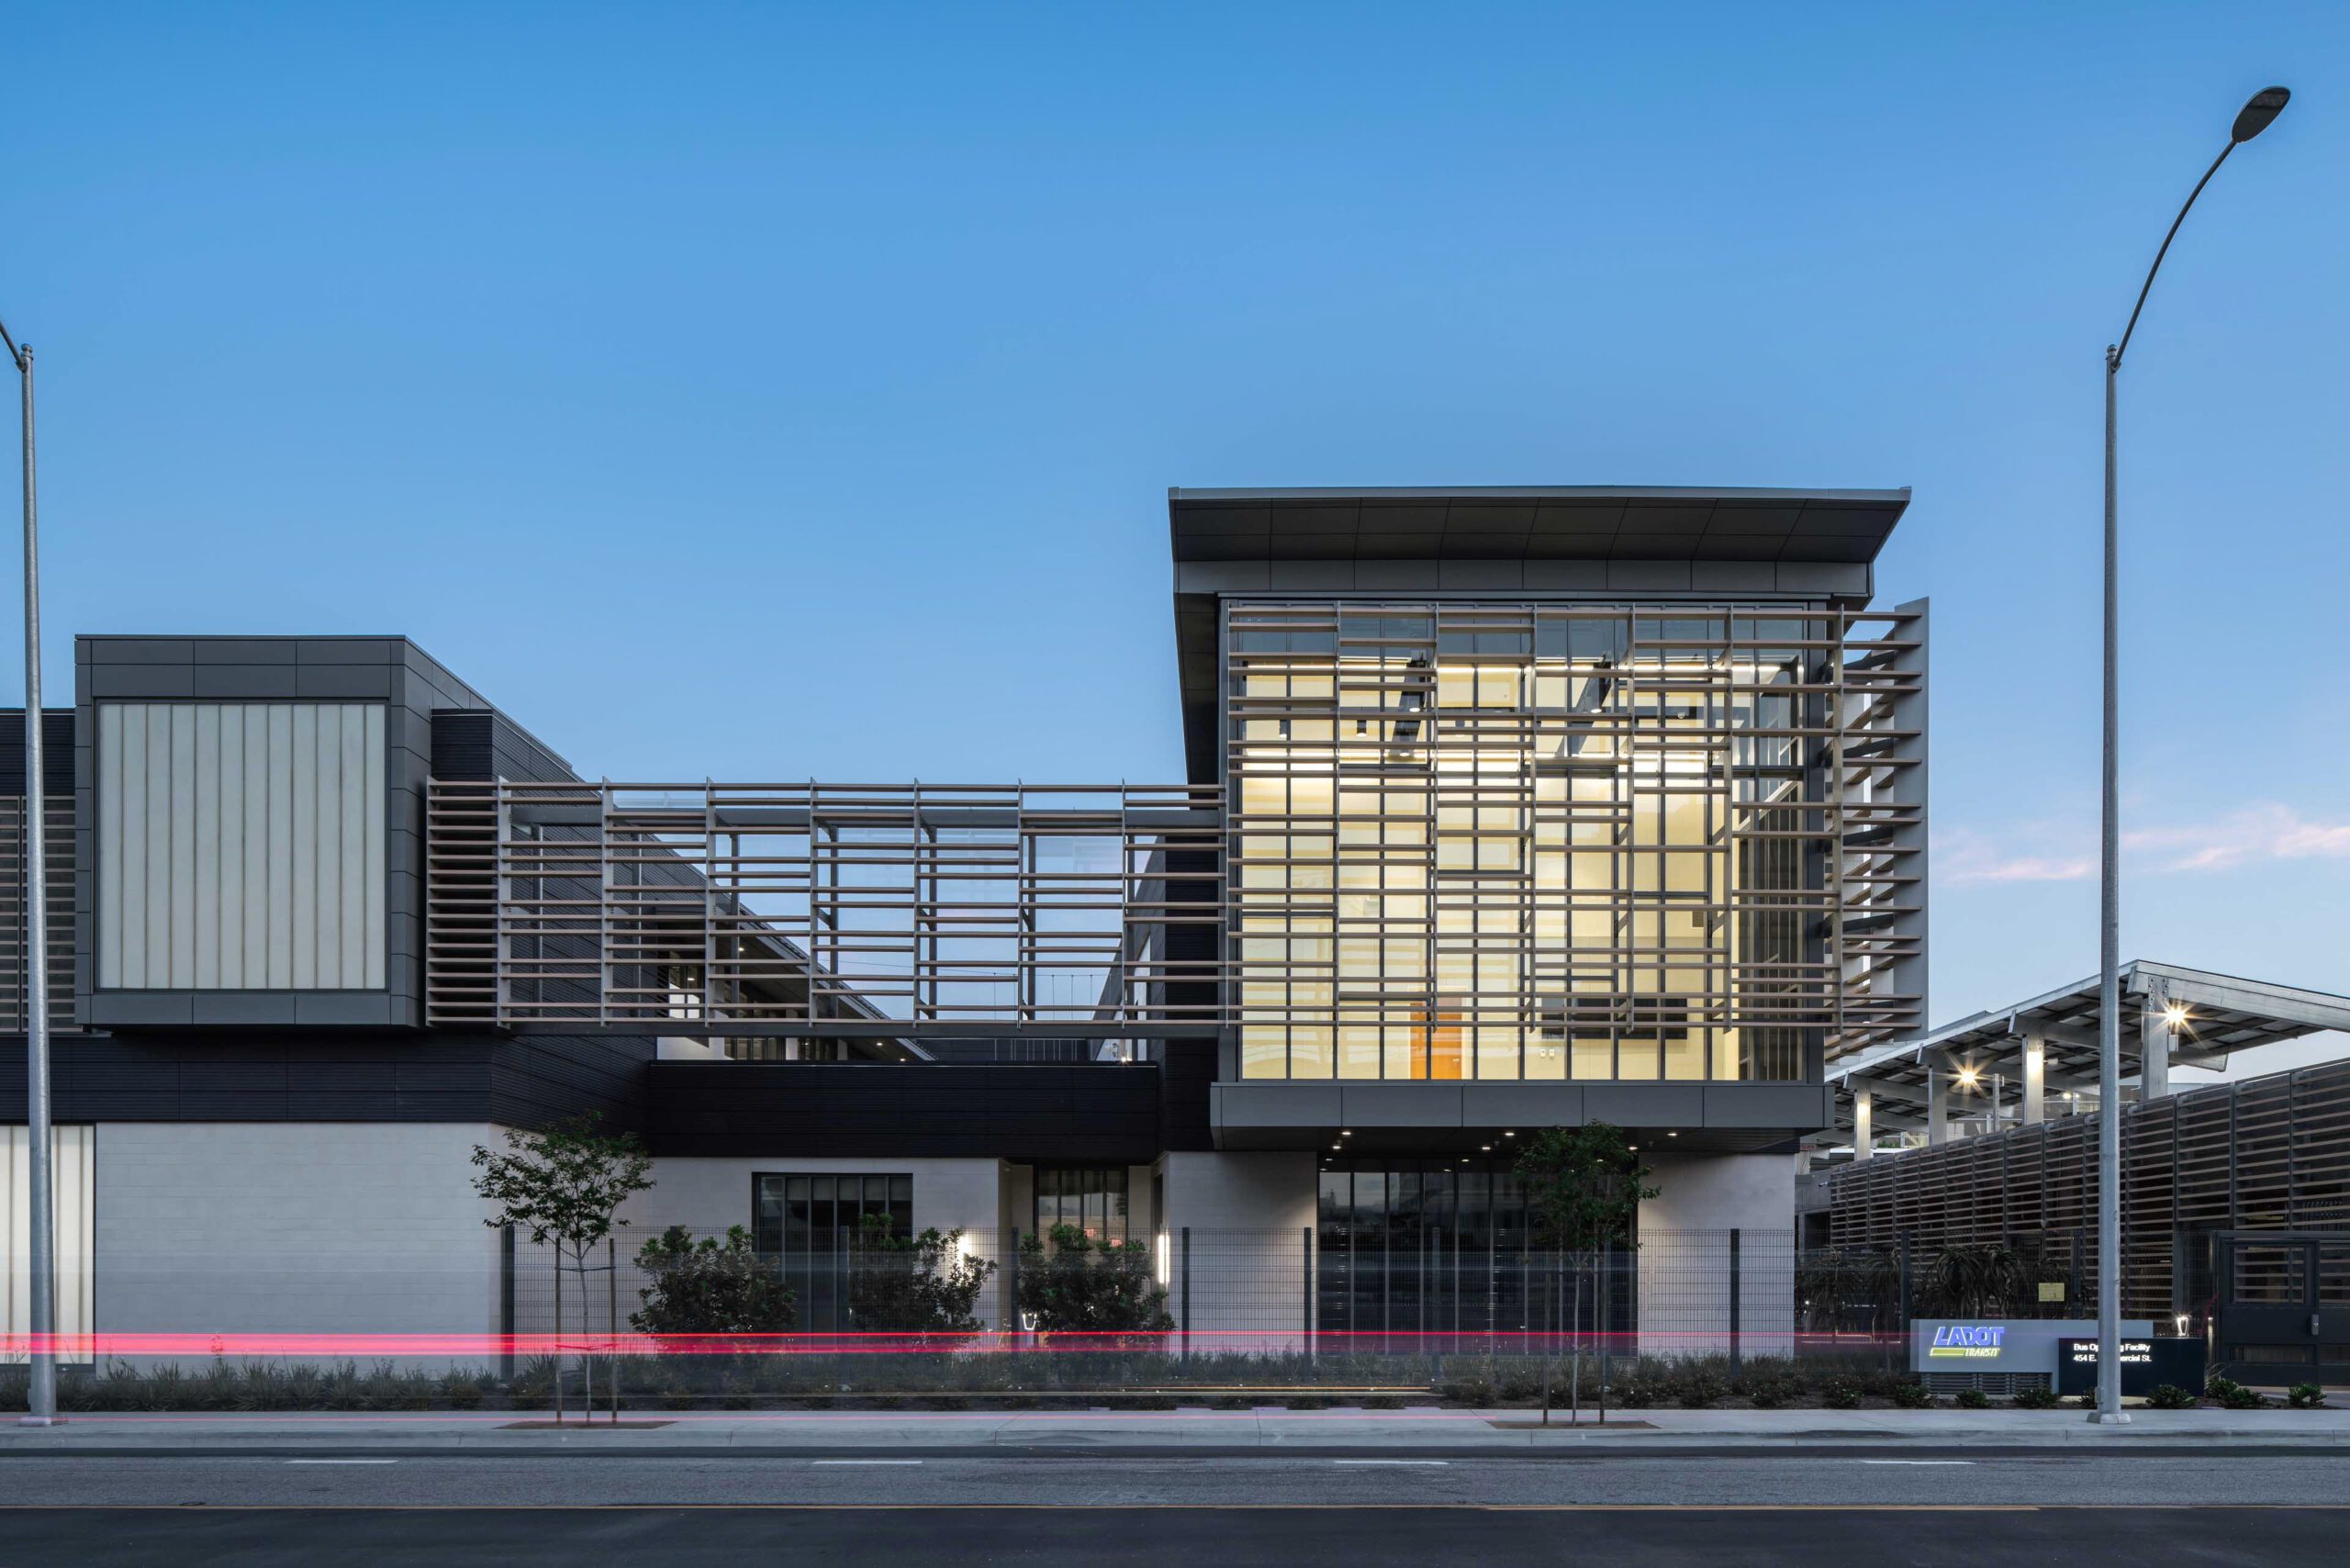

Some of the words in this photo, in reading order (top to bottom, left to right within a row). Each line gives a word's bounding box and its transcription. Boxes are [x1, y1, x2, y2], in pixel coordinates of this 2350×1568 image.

[1933, 1327, 2005, 1346] LADOT
[2074, 1343, 2088, 1351] Bus
[2125, 1343, 2151, 1352] Facility
[1964, 1348, 2000, 1357] TRANSIT
[2141, 1354, 2153, 1362] St.
